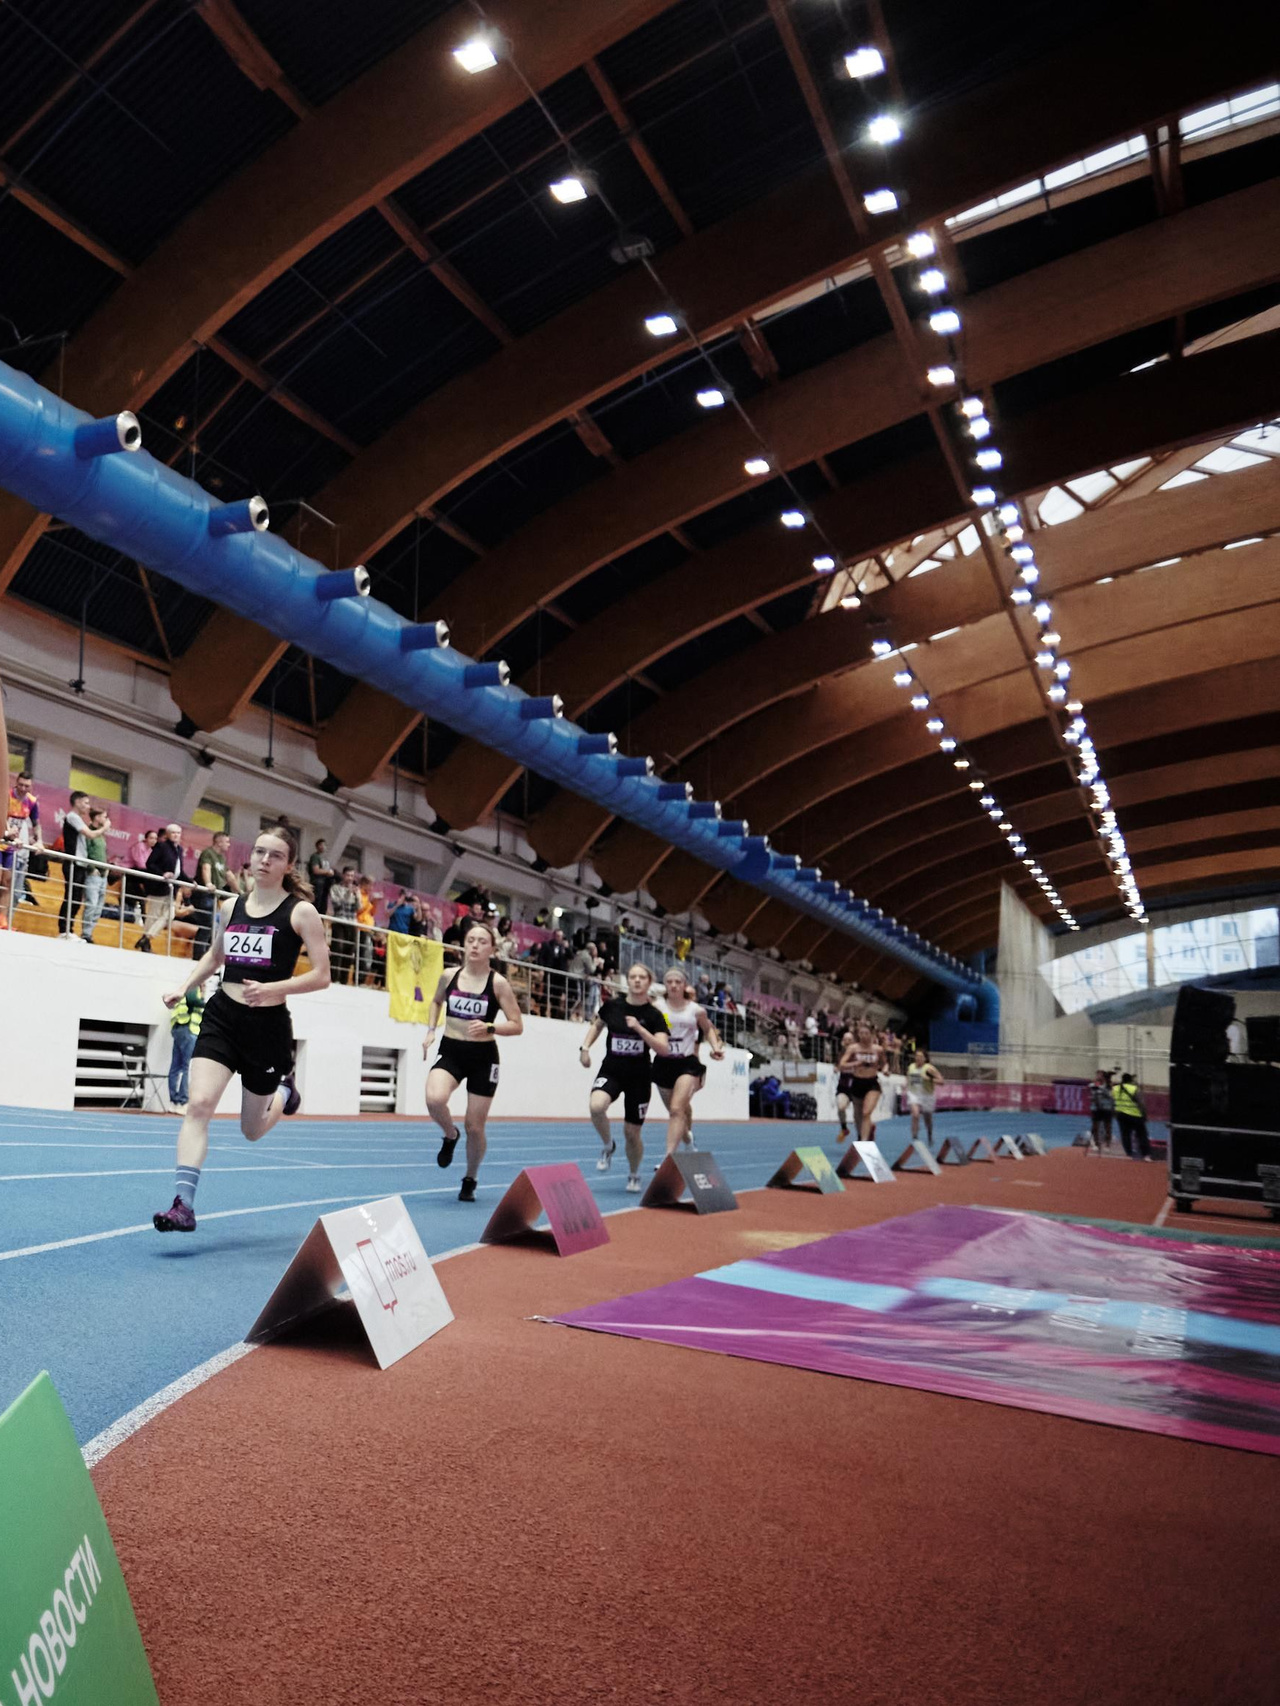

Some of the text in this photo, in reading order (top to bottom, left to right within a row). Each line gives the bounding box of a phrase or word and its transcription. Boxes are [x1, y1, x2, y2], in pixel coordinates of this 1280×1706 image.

[229, 935, 264, 955] 264
[453, 1000, 482, 1014] 440
[615, 1040, 640, 1052] 524
[493, 1067, 499, 1079] 8
[11, 1533, 102, 1706] НОВОСТИ
